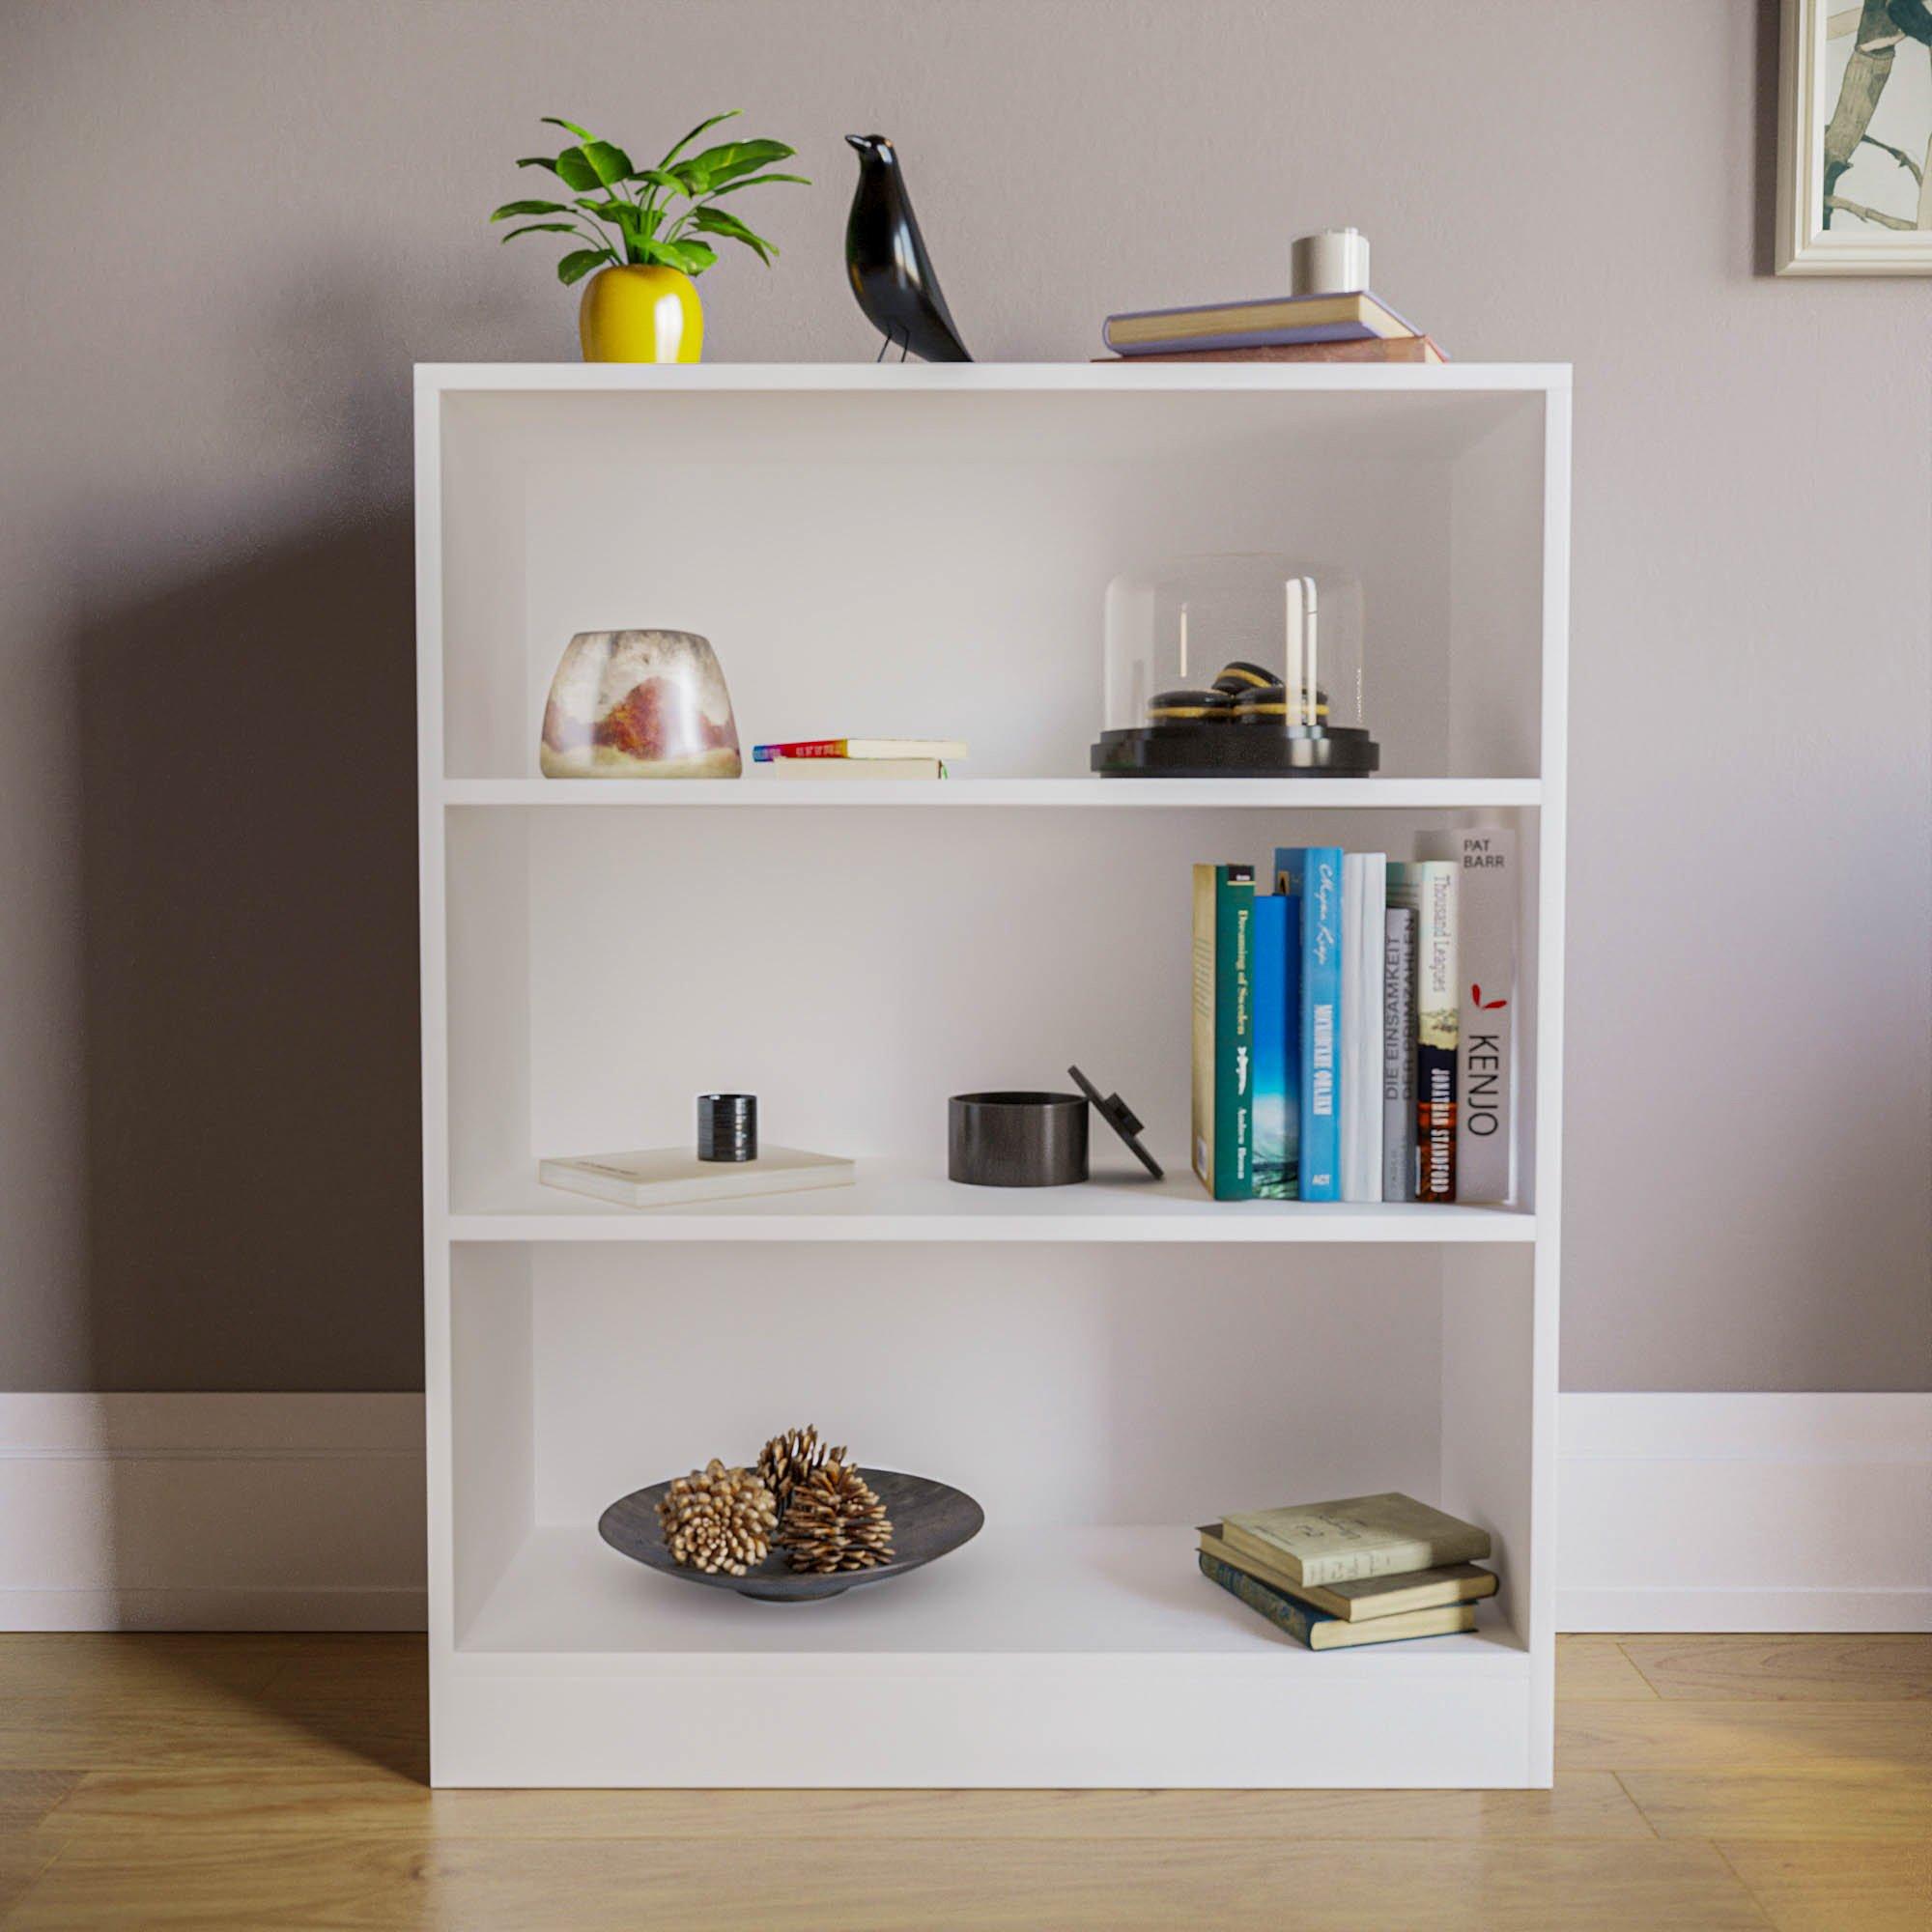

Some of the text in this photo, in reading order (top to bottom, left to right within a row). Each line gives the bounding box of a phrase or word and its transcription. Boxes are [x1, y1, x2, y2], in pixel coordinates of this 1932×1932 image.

[1463, 839, 1492, 852] PAT
[1463, 855, 1505, 868] BARR
[1430, 874, 1451, 993] Thousand Leagues
[1385, 935, 1401, 1100] DIE EINSAMKEIT
[1431, 1067, 1451, 1125] JONATHAN
[1467, 1035, 1500, 1138] KENJO
